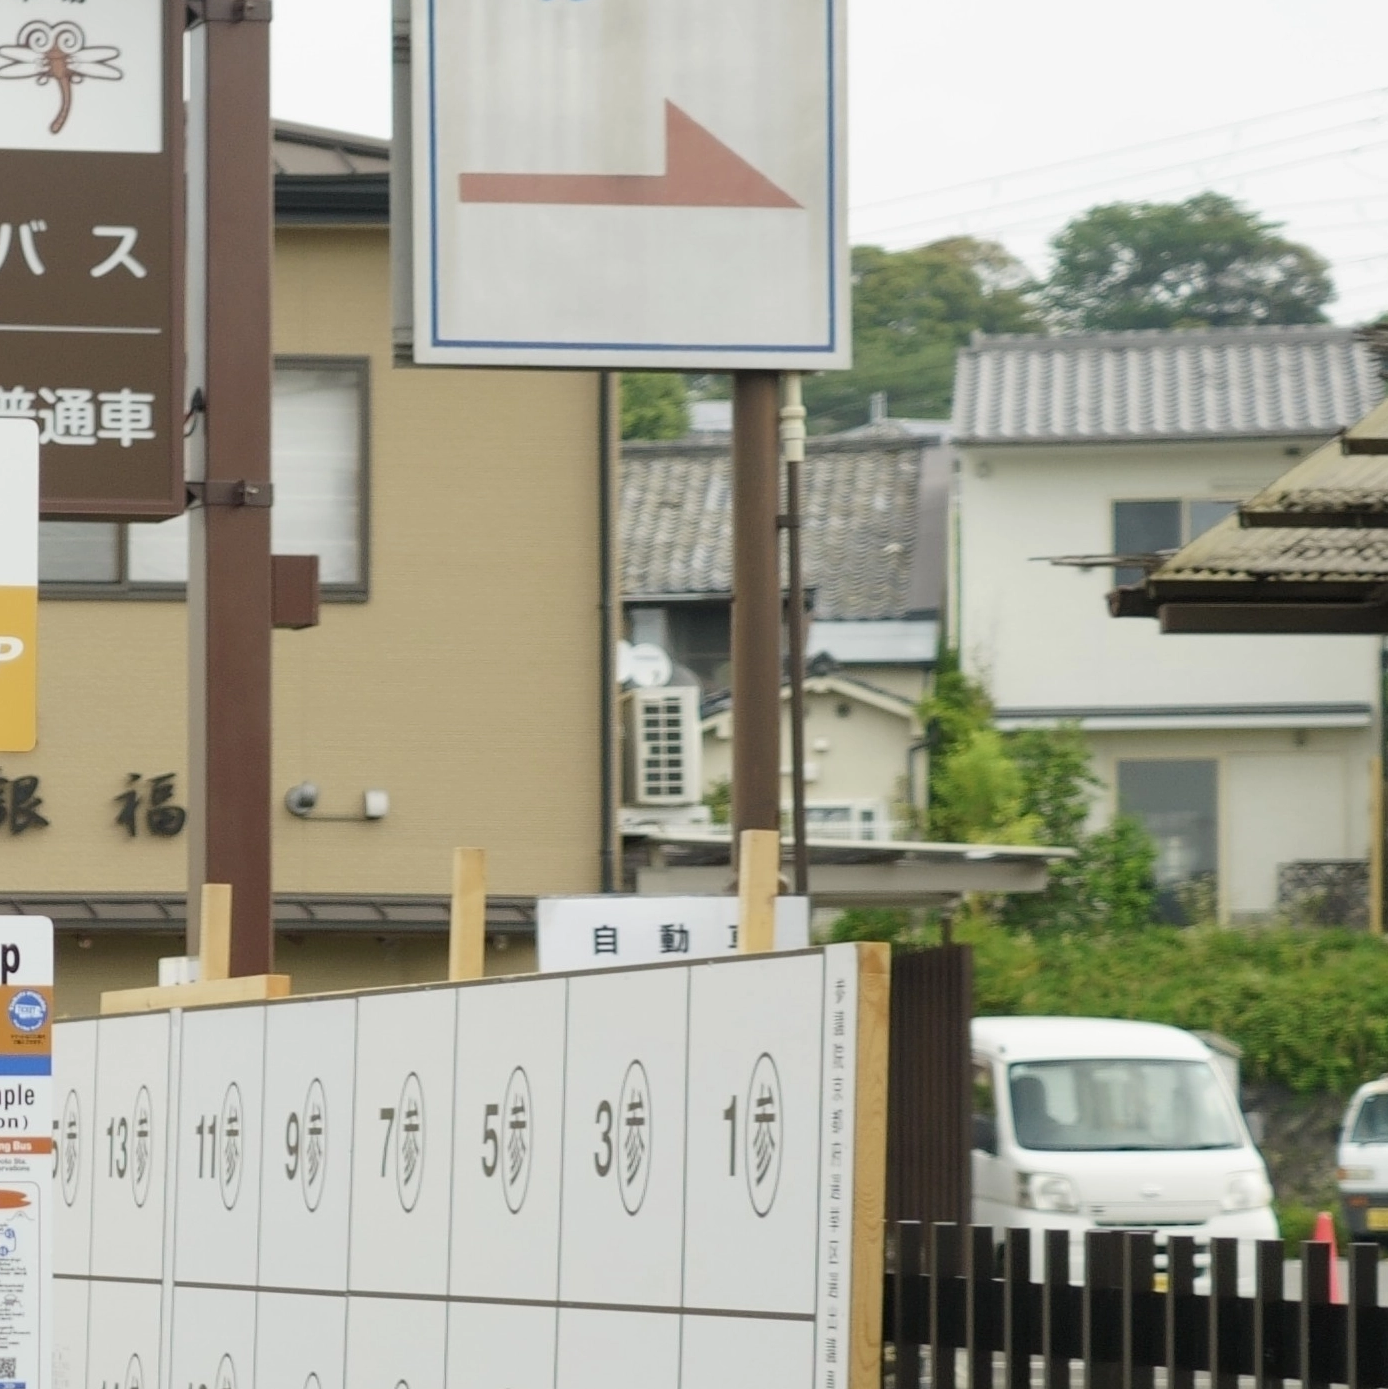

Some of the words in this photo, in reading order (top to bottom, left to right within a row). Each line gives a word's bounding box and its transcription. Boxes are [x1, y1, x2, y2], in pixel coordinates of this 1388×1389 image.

[12, 1140, 32, 1151] Bus
[107, 1117, 128, 1179] 13
[196, 1114, 217, 1179] 11
[285, 1112, 300, 1180] 9
[380, 1107, 395, 1178] 7
[481, 1103, 499, 1178] 5
[594, 1100, 613, 1178] 3
[723, 1095, 737, 1177] 1
